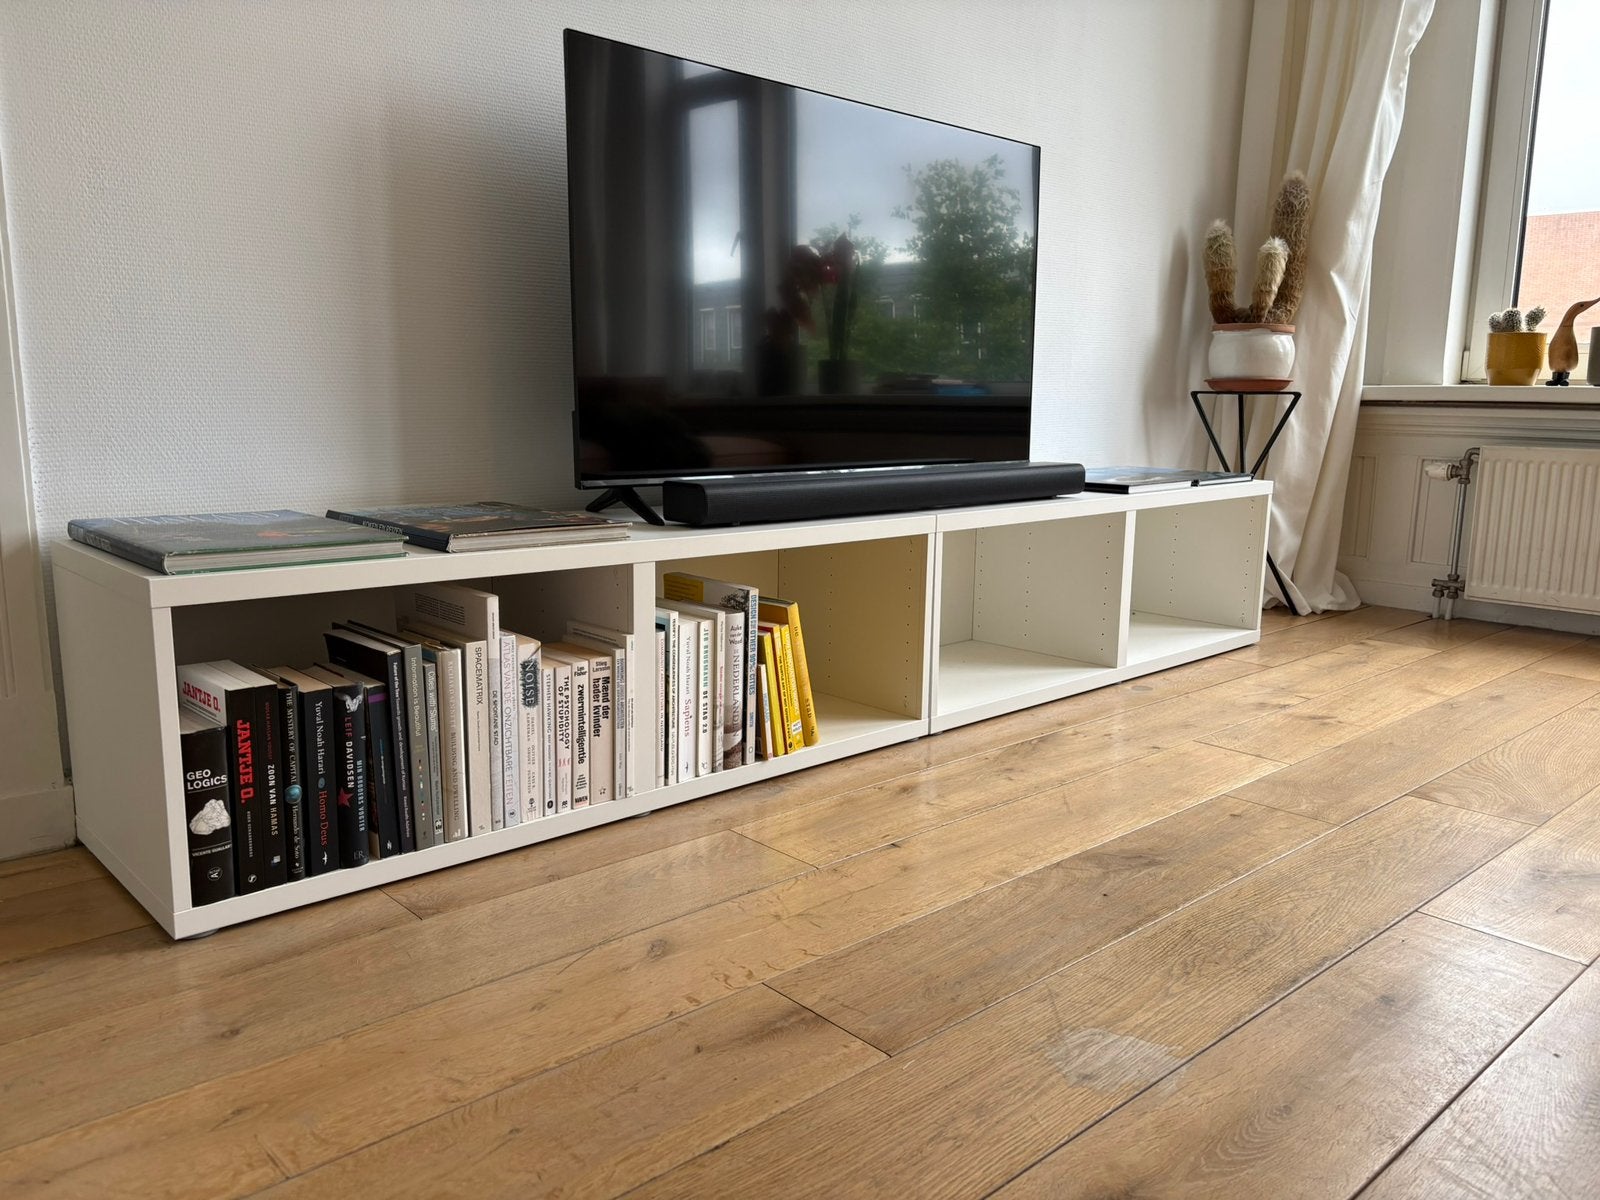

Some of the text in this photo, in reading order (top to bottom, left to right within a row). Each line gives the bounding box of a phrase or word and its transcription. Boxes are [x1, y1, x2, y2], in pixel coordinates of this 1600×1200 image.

[428, 672, 436, 690] Cities
[475, 647, 483, 705] SPACEMATRIX
[525, 661, 534, 706] NOISE
[182, 682, 211, 708] JANTJE
[505, 692, 512, 704] DE
[558, 686, 564, 701] OF
[315, 702, 323, 724] Yuval
[593, 678, 601, 737] hader kvinder
[683, 699, 692, 737] Sapiens
[576, 684, 586, 764] zwermintelligentie
[288, 743, 295, 752] OF
[505, 707, 513, 772] ONZICHTBARE
[237, 720, 253, 785] JANTJE
[317, 749, 326, 774] Harari
[346, 742, 354, 788] DAVIDSEN
[186, 769, 211, 780] GEO
[187, 774, 228, 790] LOGICS
[240, 788, 254, 803] O.
[318, 791, 327, 820] Homo
[320, 822, 329, 846] Deus
